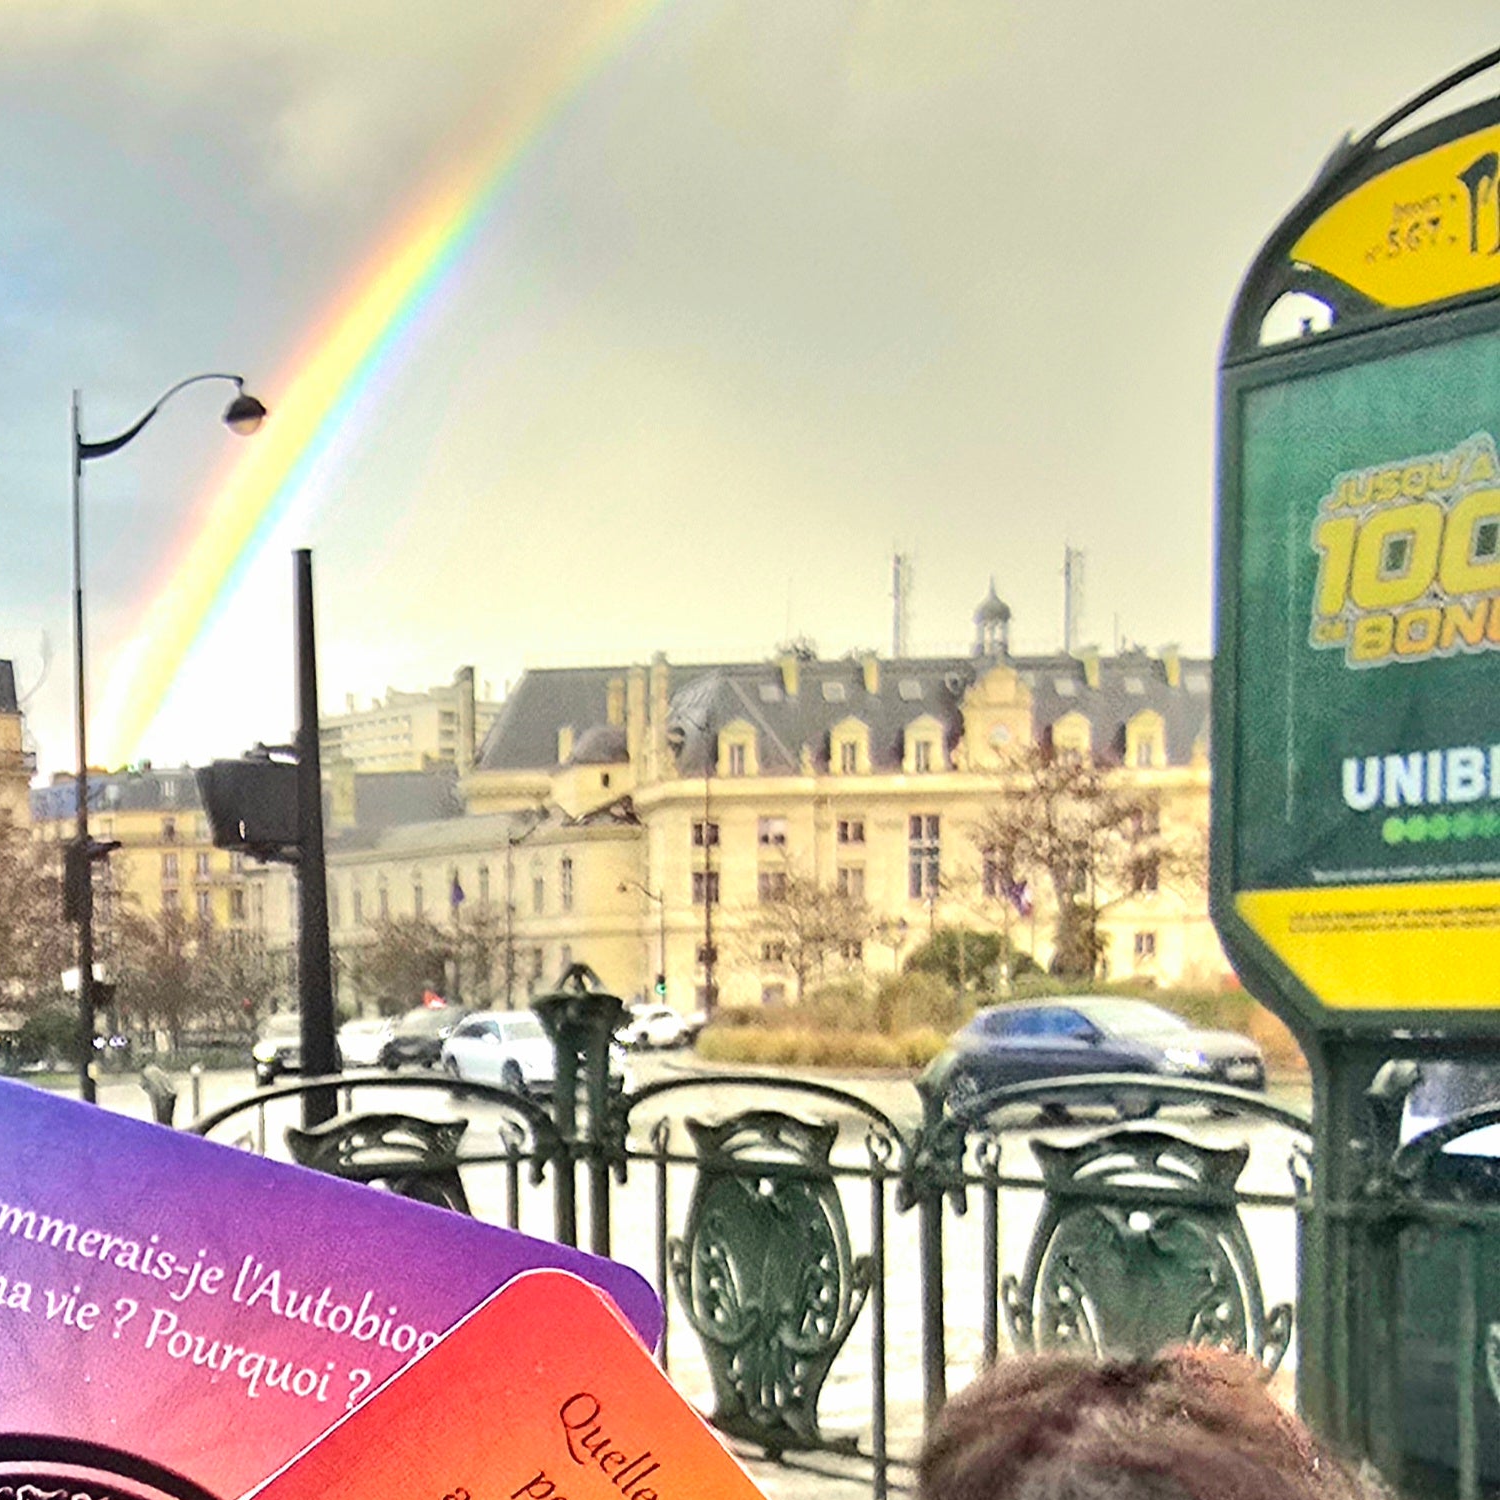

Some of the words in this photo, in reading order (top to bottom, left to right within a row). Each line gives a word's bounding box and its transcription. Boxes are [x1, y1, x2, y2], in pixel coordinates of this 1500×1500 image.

[1342, 744, 1500, 812] UNIB
[43, 1284, 102, 1332] vie
[111, 1296, 140, 1340] ?
[144, 1307, 336, 1403] Pourquoi
[345, 1368, 372, 1411] ?
